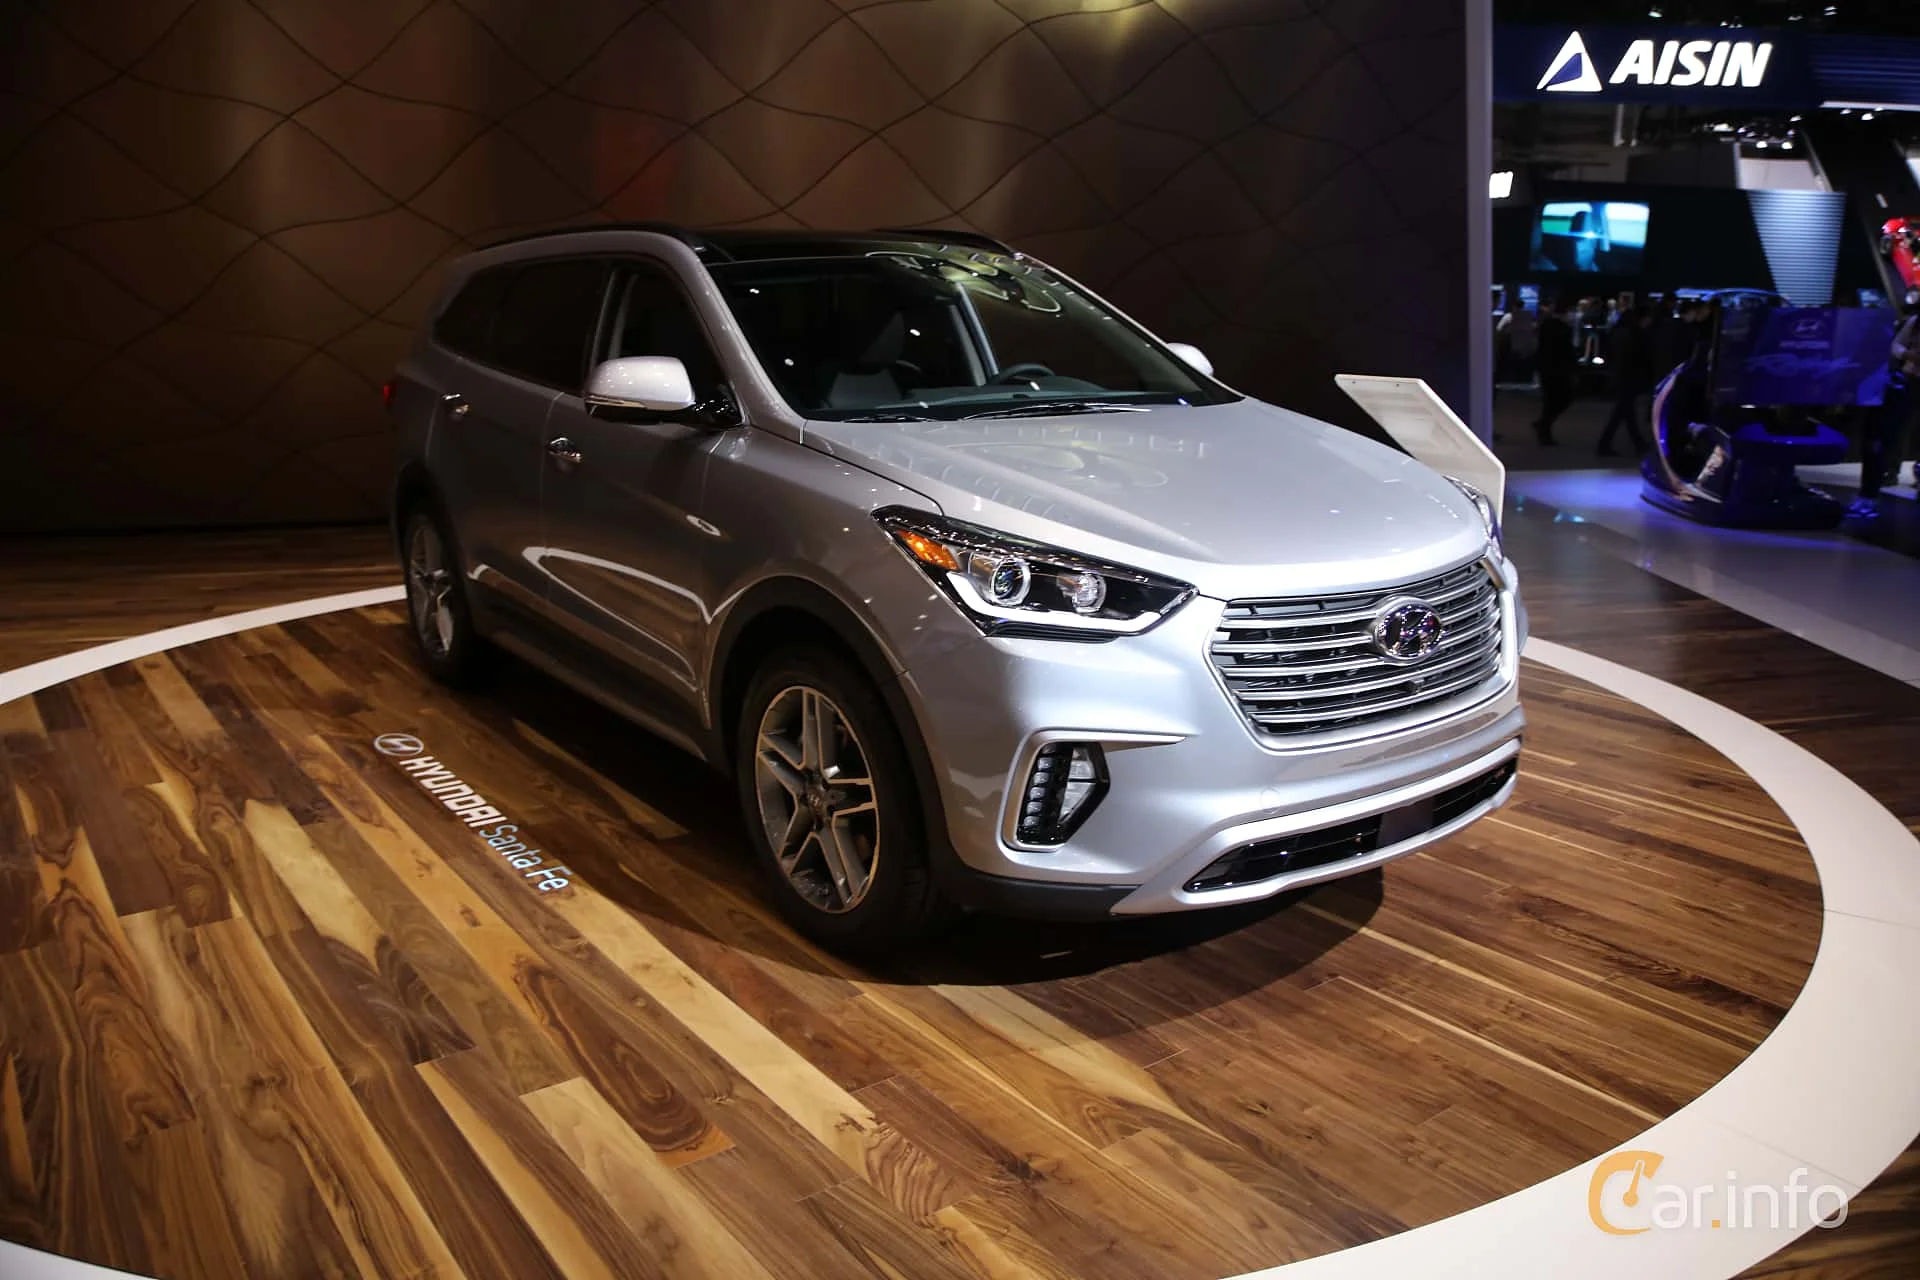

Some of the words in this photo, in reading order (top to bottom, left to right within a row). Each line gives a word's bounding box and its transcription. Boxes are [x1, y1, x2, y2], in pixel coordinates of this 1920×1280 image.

[1609, 40, 1773, 87] AISIN
[400, 756, 507, 827] HYUNDAI
[480, 824, 543, 869] Santa
[525, 865, 573, 891] Fe
